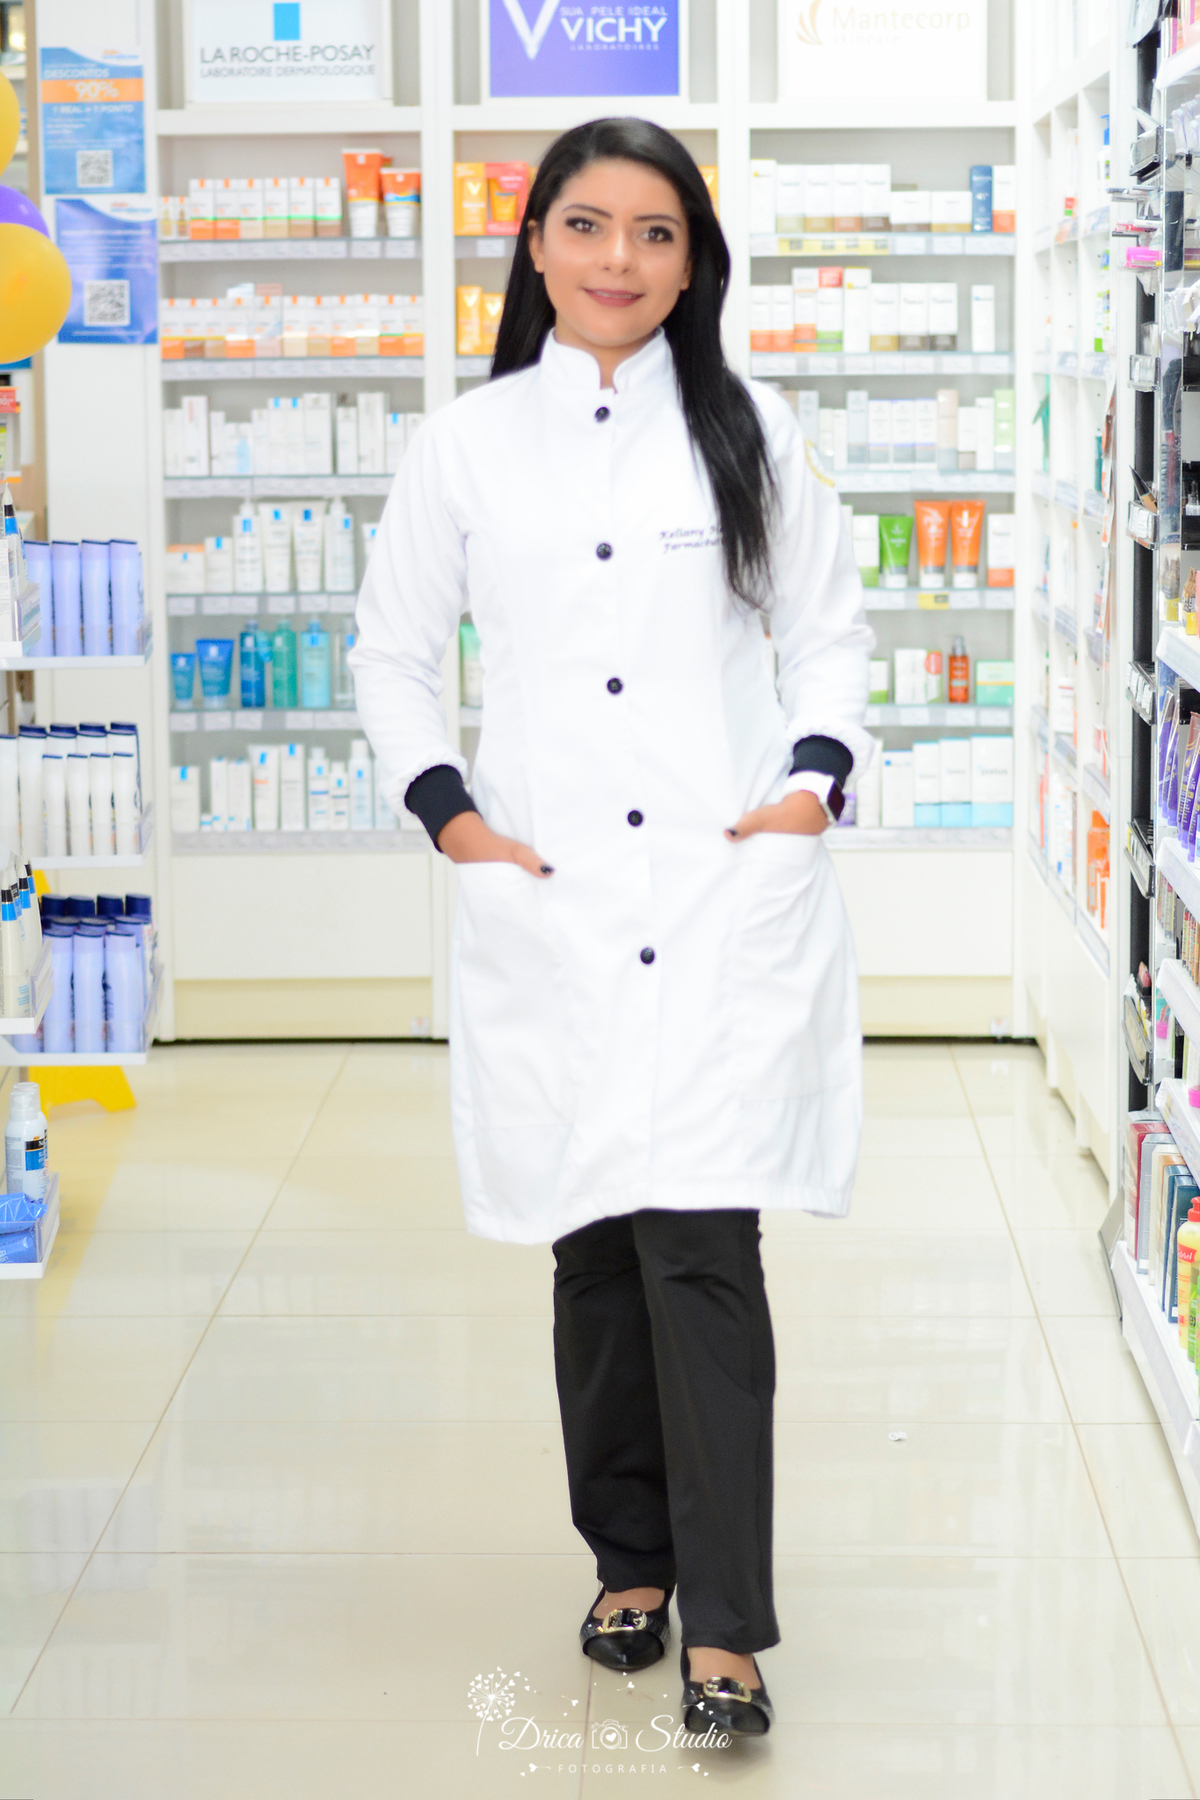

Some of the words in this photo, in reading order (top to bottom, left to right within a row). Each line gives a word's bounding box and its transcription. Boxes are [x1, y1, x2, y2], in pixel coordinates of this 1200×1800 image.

[560, 6, 584, 16] SUA
[590, 6, 624, 16] PELE
[628, 6, 668, 16] IDEAL
[832, 6, 971, 32] Mantecorp
[560, 17, 668, 43] VICHY
[199, 46, 226, 64] LA
[229, 44, 376, 63] ROCHE-POSAY
[570, 43, 660, 51] LABORATOIRES
[44, 69, 110, 78] DESCONTOS
[200, 66, 273, 79] LABORATOIRE
[275, 64, 376, 77] DERMATOLOGIQUE
[74, 81, 119, 98] 90%
[100, 104, 135, 113] PONTO
